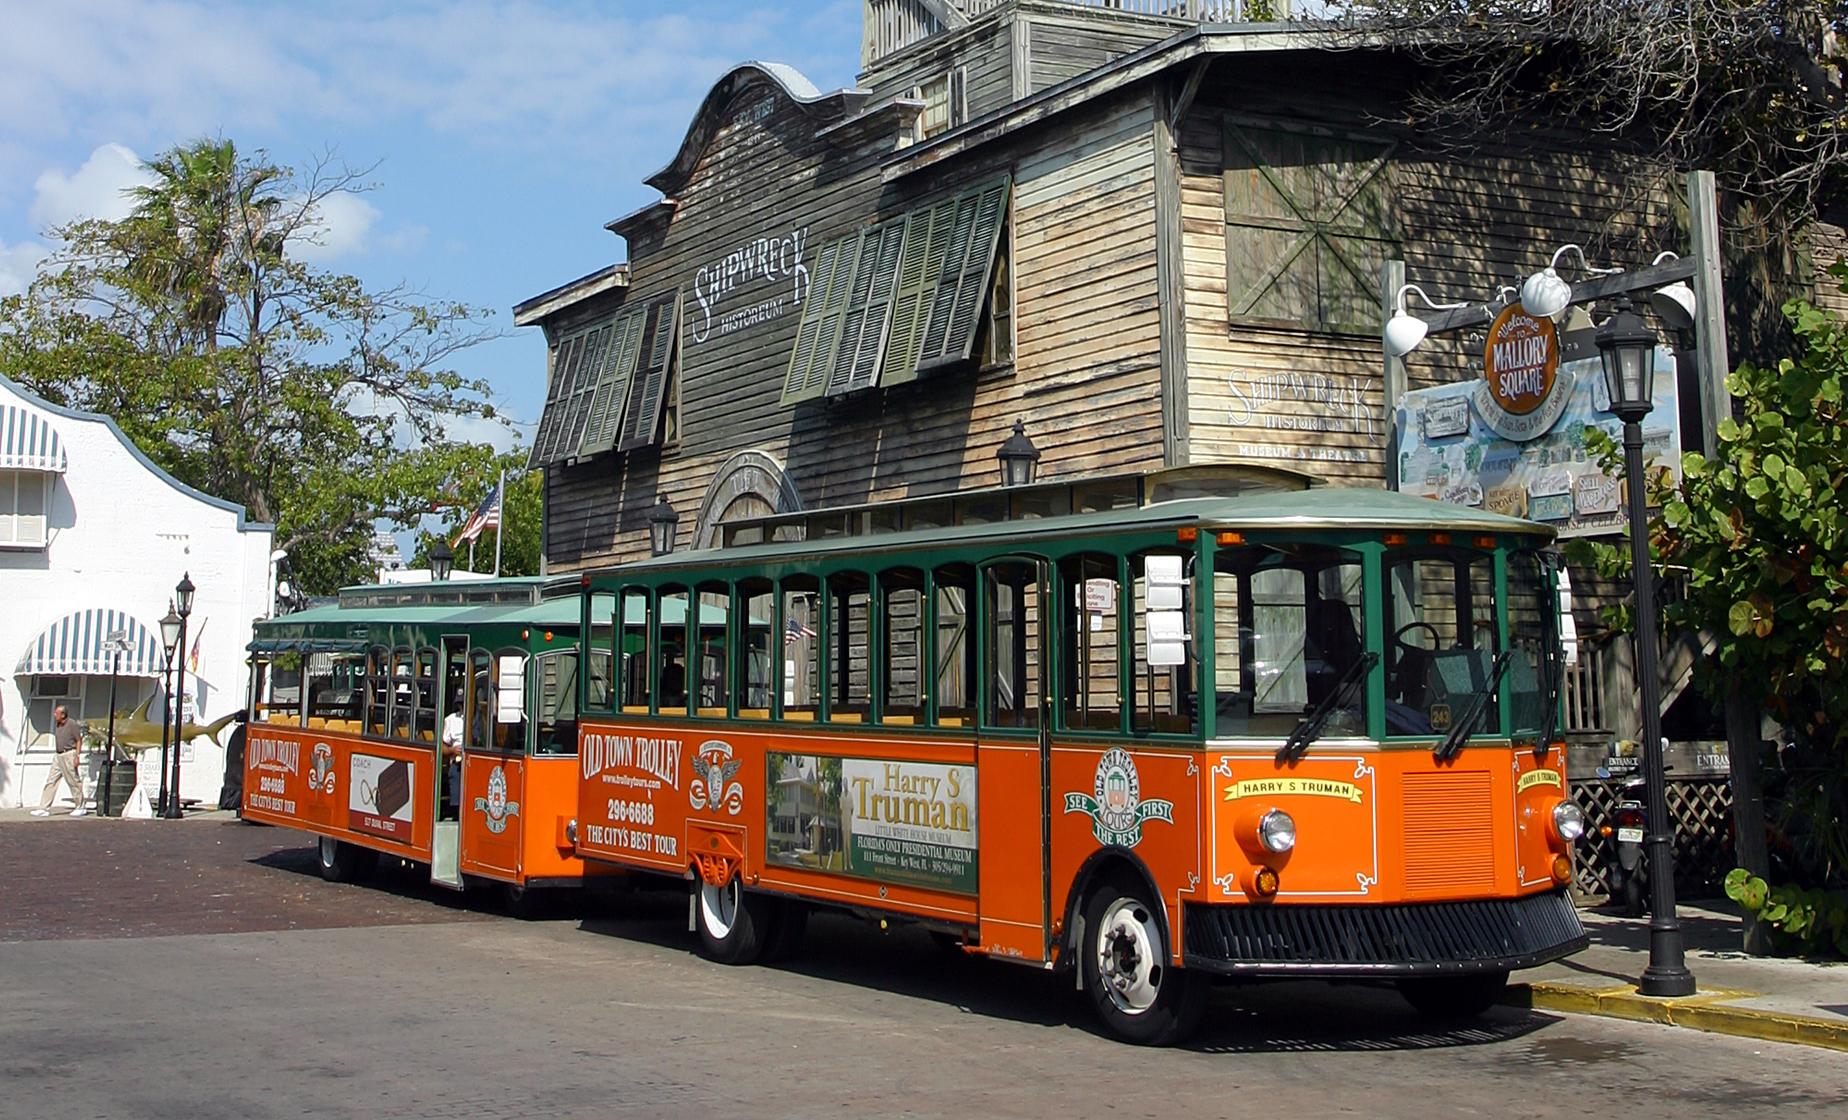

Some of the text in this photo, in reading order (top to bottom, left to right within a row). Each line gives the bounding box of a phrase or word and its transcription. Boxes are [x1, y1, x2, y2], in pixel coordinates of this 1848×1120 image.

[692, 227, 810, 343] SHIPWRECK
[721, 299, 784, 334] HISTOREUM
[1497, 314, 1540, 338] Welcome
[1493, 334, 1549, 372] MALLORY
[1499, 367, 1544, 400] SQUARE
[1228, 368, 1382, 447] SHIPWRECK
[1239, 445, 1291, 458] MUSEUM
[1310, 449, 1369, 462] THEATRE
[1488, 490, 1521, 511] SPONGE
[353, 757, 371, 768] COACH
[583, 734, 603, 780] OLD
[604, 735, 633, 769] TOWN
[635, 736, 682, 791] TROLLEY
[1608, 757, 1639, 766] ENTRANCE
[1697, 754, 1730, 767] ENTRAN
[602, 774, 661, 789] www.trolleytours.com
[883, 763, 960, 801] Harry S
[1243, 781, 1350, 795] HARRY S TRUMAN
[852, 777, 971, 832] Truman
[1069, 795, 1169, 817] SEE FIRST
[1102, 808, 1134, 829] TOURS
[587, 824, 677, 856] THE CITY'S BEST TOUR
[1095, 822, 1140, 846] THE REST
[885, 839, 901, 853] ONLY
[902, 841, 943, 859] PRESIDENTIAL
[943, 847, 972, 863] MUSEUM
